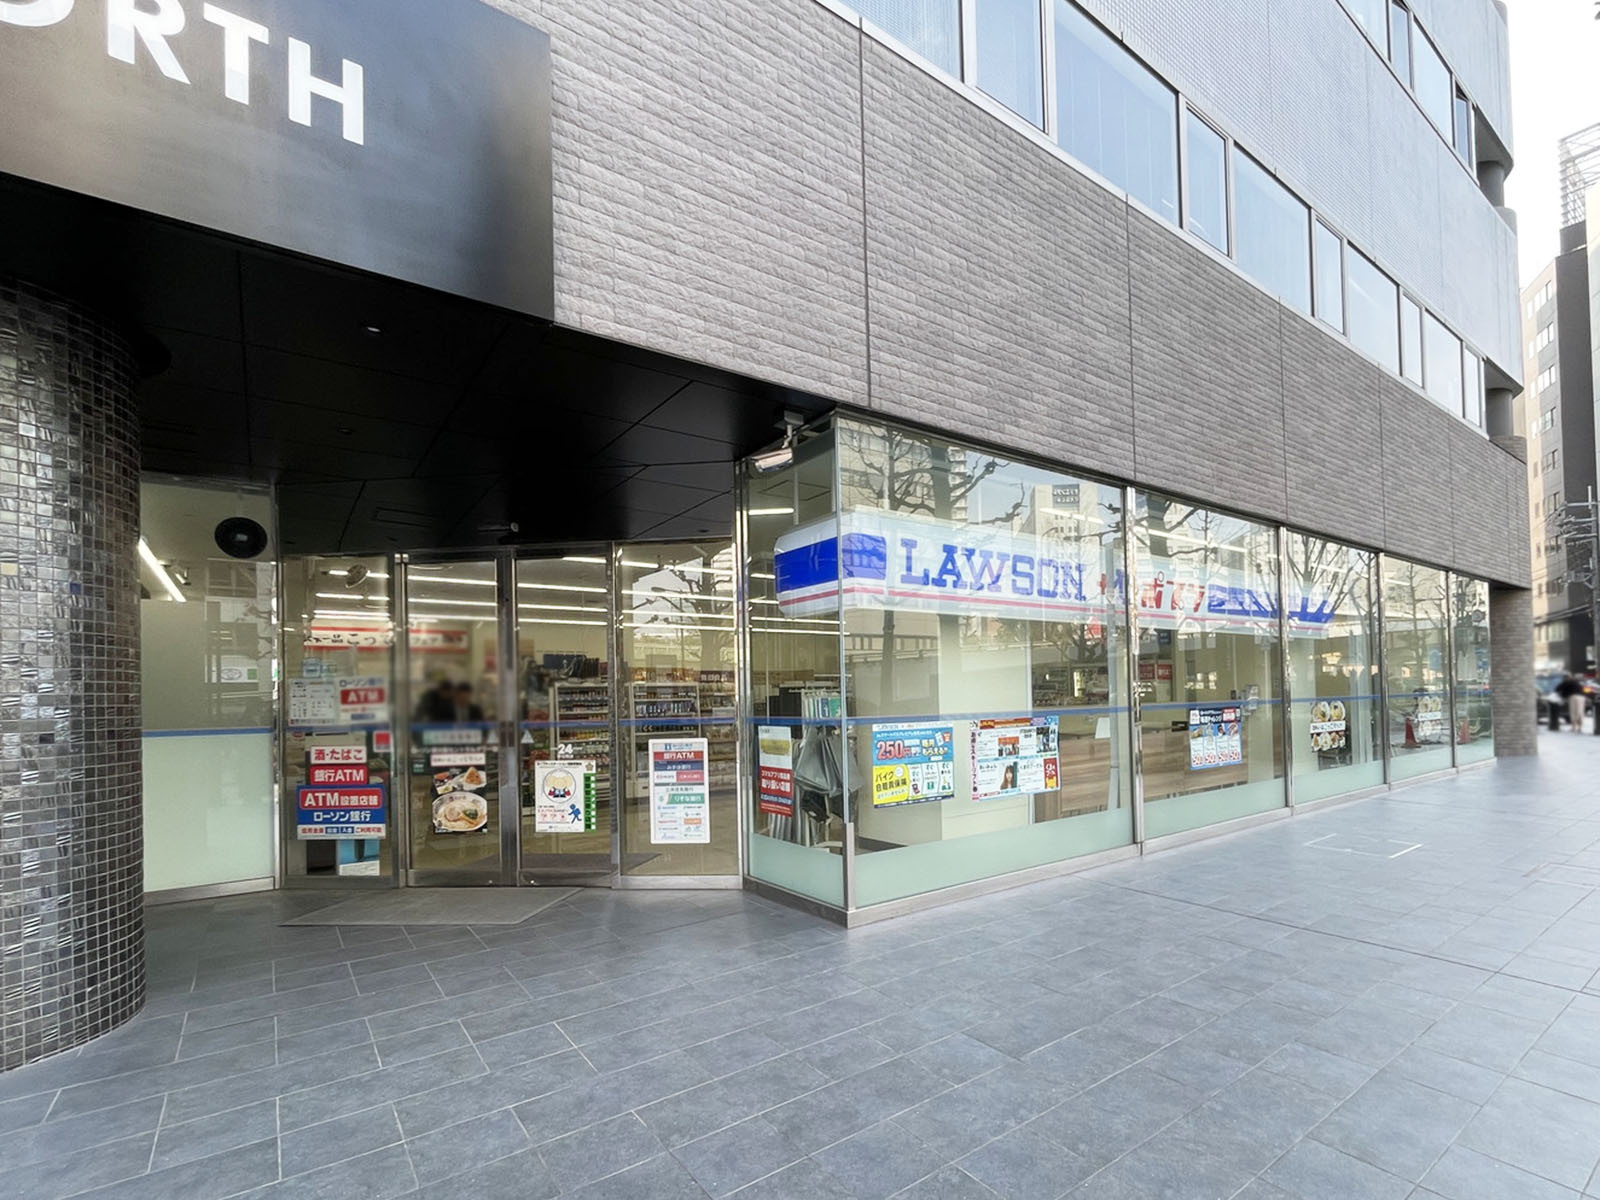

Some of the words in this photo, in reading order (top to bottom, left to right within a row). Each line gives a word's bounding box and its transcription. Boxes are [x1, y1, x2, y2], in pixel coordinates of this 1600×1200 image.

[0, 0, 364, 146] RTH
[900, 538, 1087, 601] LAWSON
[347, 690, 379, 703] ATM
[558, 743, 573, 754] 24
[877, 739, 904, 760] 250
[313, 769, 364, 782] 銀行ATM
[875, 771, 894, 782] バイク
[313, 810, 372, 822] ローソン銀行
